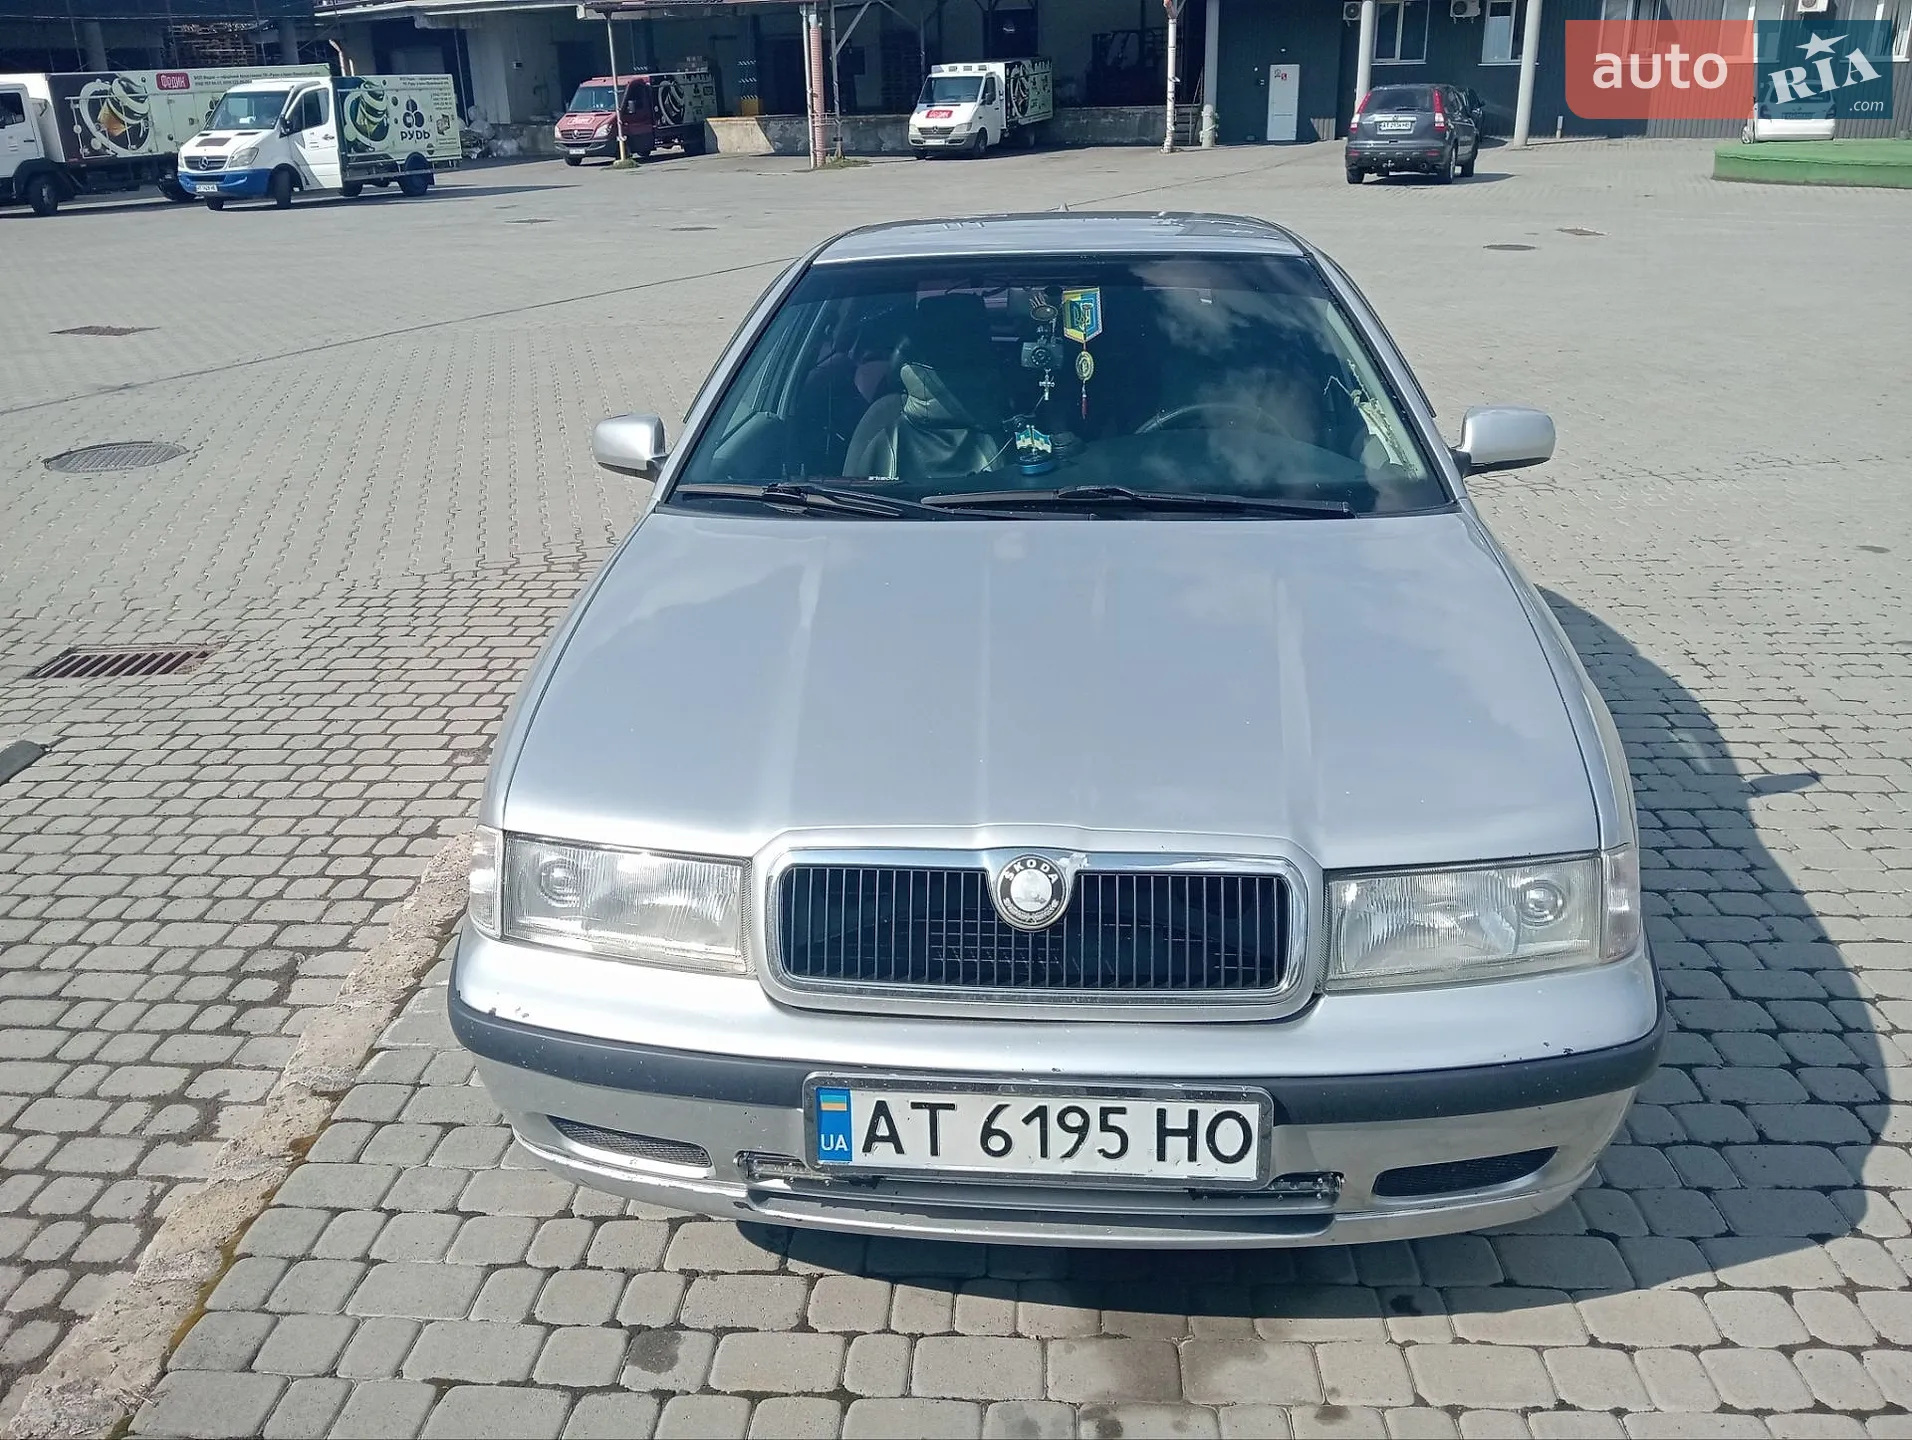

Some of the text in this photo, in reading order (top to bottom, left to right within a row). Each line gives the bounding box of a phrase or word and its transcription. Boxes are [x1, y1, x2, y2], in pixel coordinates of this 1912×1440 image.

[821, 1133, 849, 1152] UA
[861, 1100, 1253, 1164] AT 6195 HO
